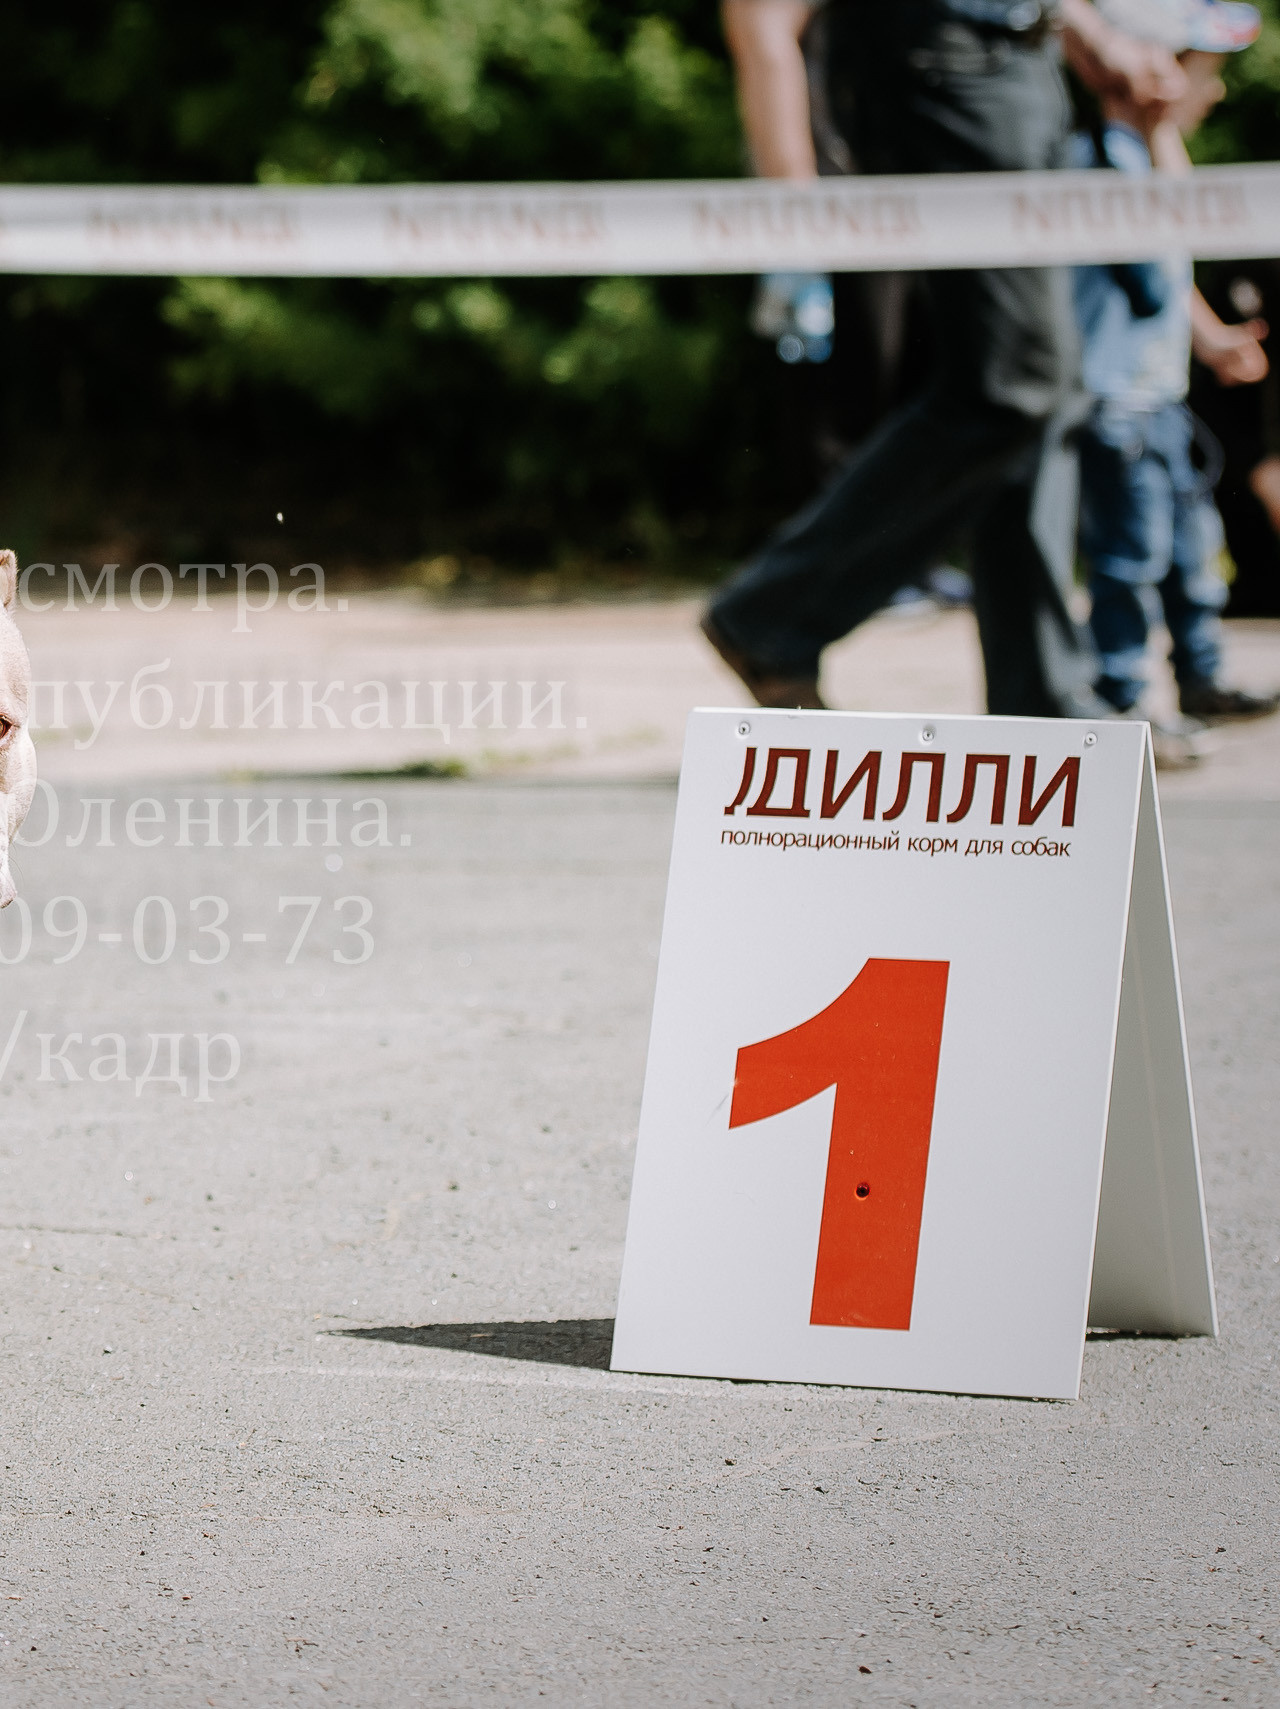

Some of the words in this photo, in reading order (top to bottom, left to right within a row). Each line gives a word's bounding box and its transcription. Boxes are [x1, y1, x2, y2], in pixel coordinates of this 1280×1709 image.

[721, 829, 900, 852] полнорационный
[907, 837, 958, 857] корм
[965, 838, 1003, 857] для
[1010, 835, 1071, 858] собак
[728, 957, 950, 1331] 1
